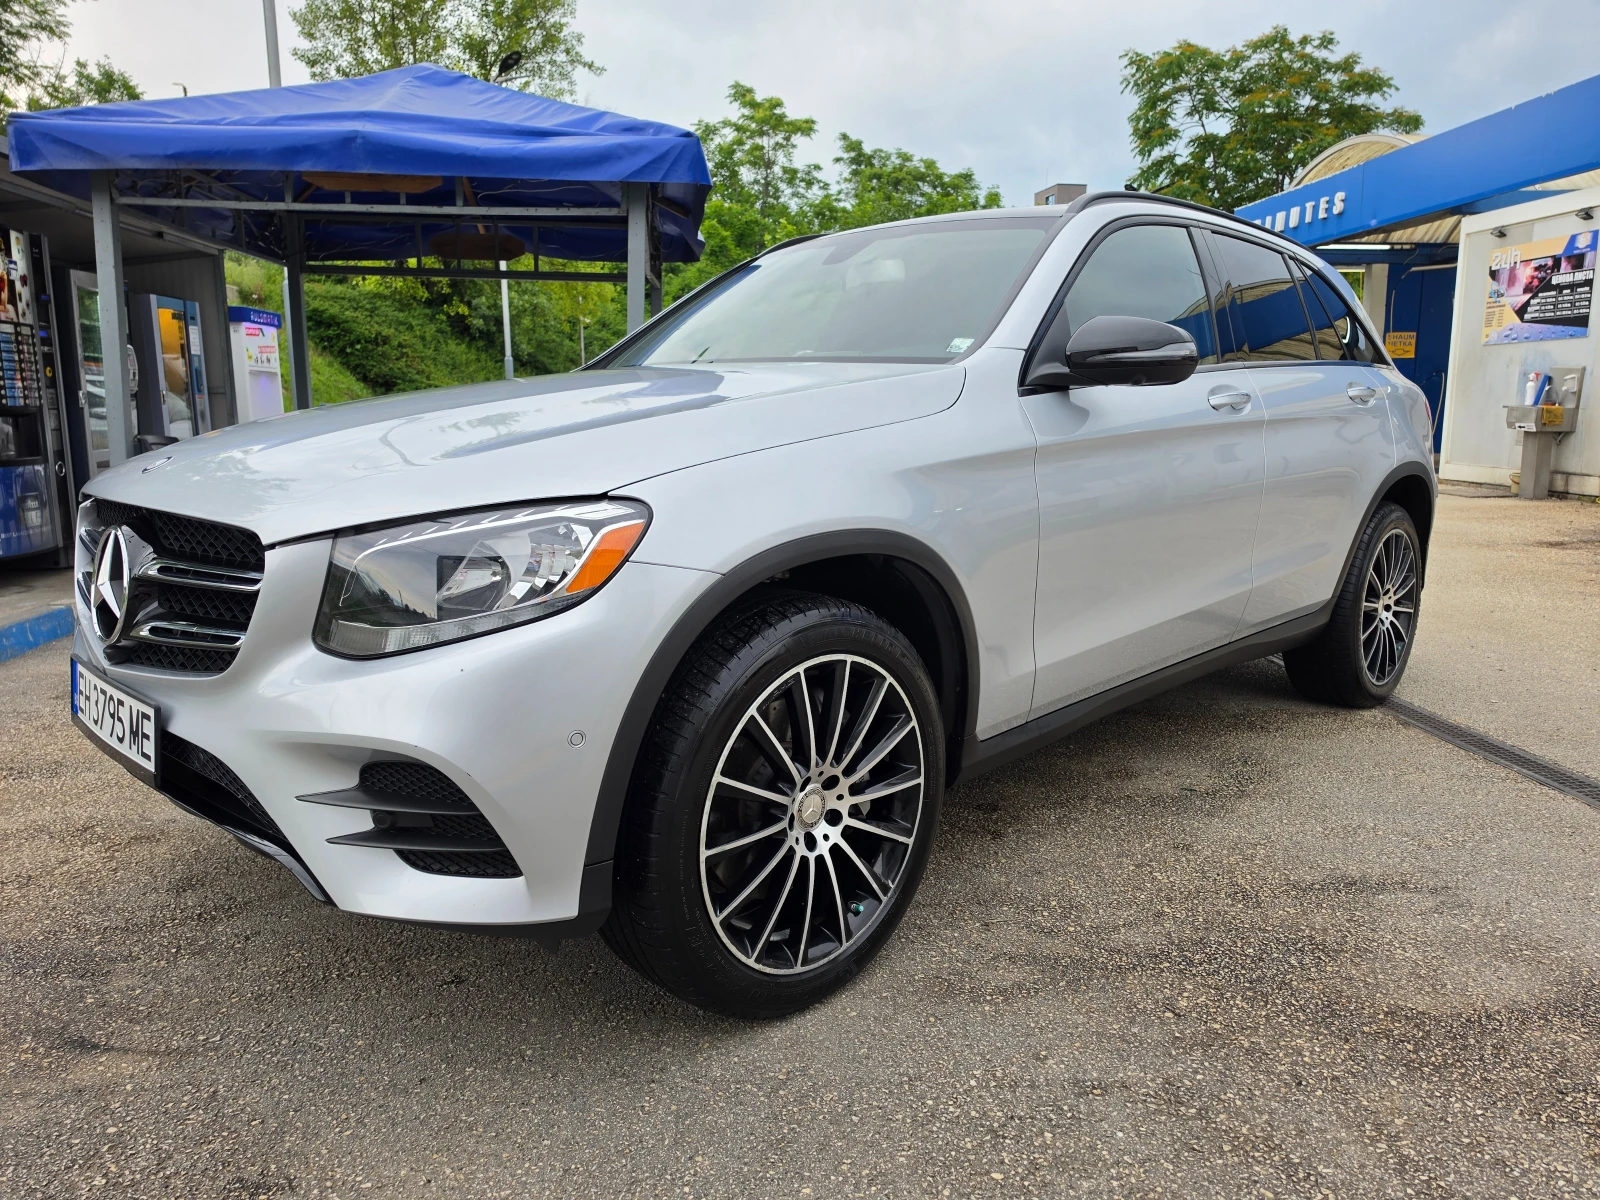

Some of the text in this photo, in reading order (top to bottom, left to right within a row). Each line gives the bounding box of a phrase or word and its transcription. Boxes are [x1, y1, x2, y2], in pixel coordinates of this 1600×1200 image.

[1252, 191, 1346, 232] INUTES
[79, 670, 152, 763] EH 3795 ME
